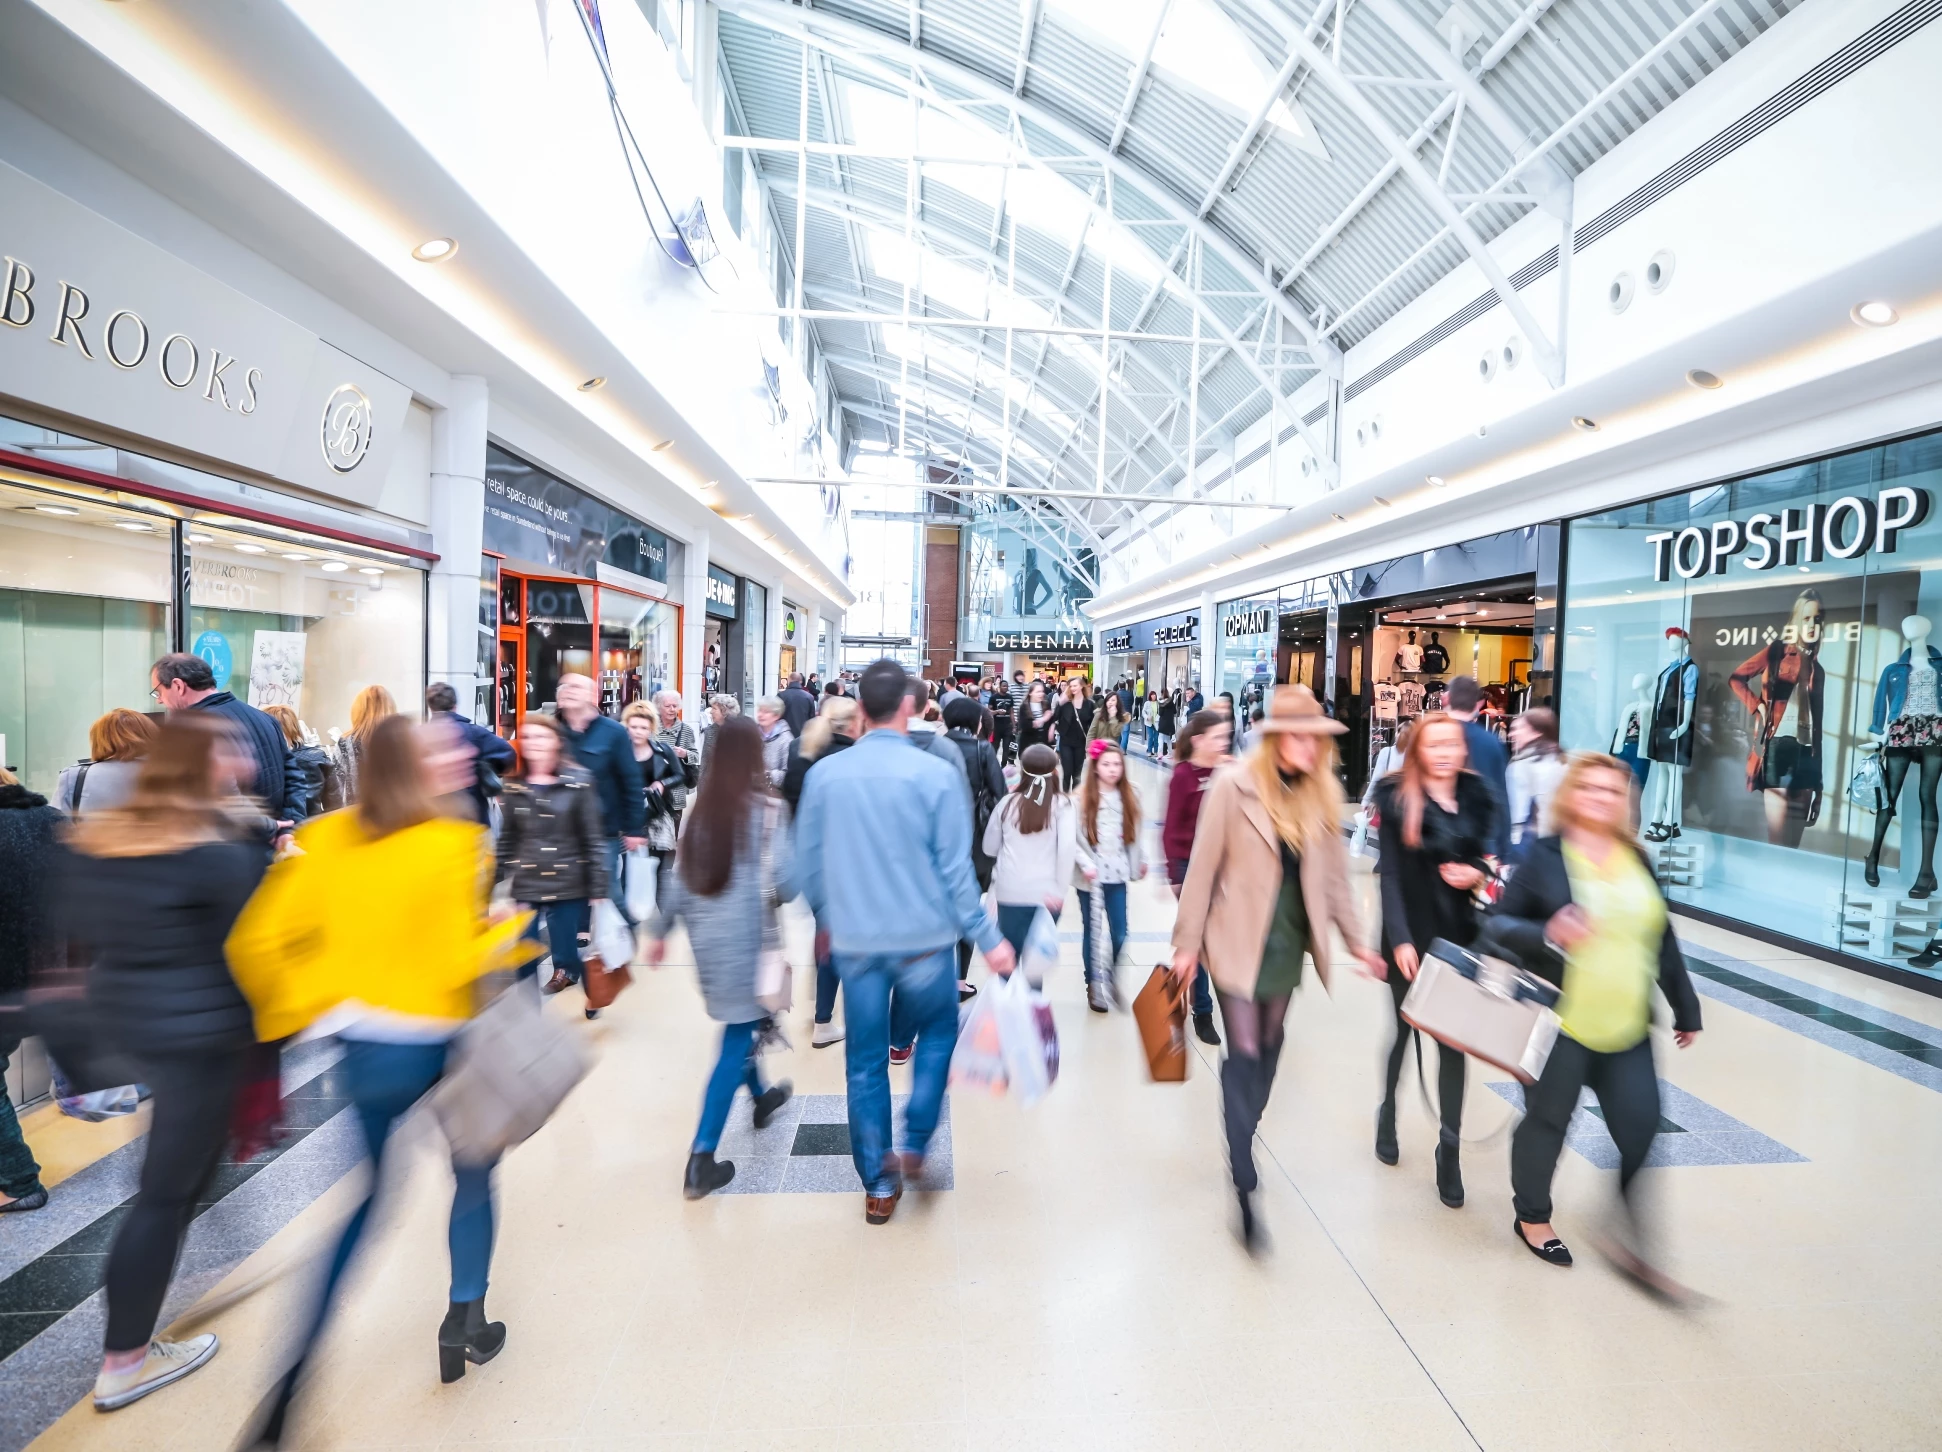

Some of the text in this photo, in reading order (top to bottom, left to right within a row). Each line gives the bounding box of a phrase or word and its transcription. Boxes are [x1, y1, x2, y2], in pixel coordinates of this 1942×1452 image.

[0, 255, 263, 416] BROOKS
[487, 478, 504, 495] retail
[506, 486, 527, 505] space
[527, 495, 545, 512] could
[545, 500, 553, 516] be
[1645, 486, 1929, 582] TOPSHOP
[640, 537, 664, 564] Boutique?
[722, 583, 735, 607] INC
[1223, 610, 1267, 637] TOPMAN
[996, 634, 1090, 649] DEBENHA
